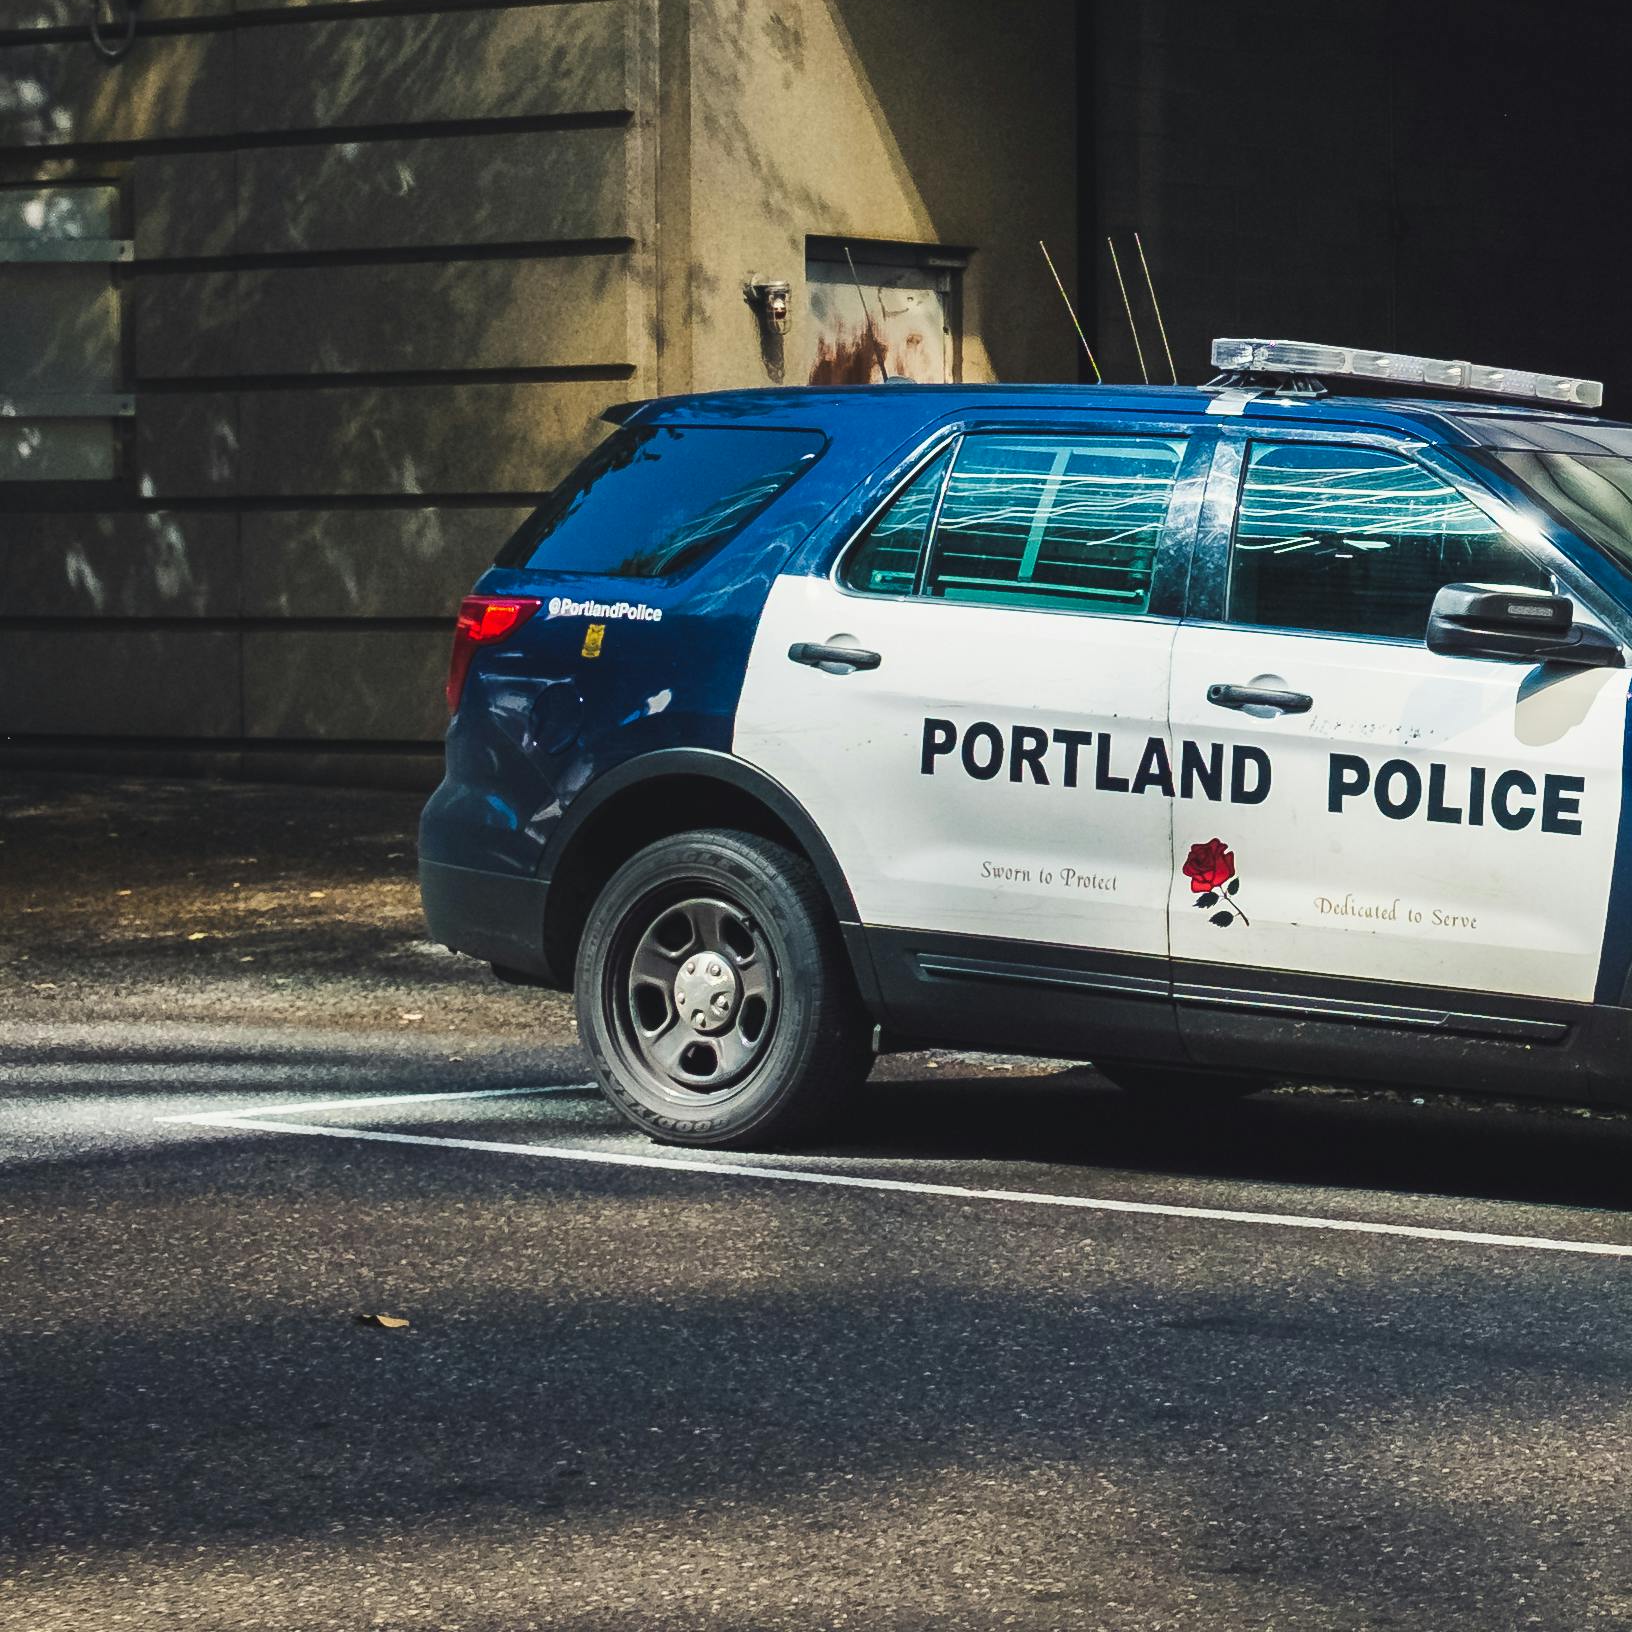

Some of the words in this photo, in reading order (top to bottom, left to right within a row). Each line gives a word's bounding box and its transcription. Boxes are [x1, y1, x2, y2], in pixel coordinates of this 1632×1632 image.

[548, 597, 662, 622] @PortlandPolice
[920, 718, 1273, 806] PORTLAND
[1327, 752, 1586, 836] POLICE
[980, 860, 1031, 882] Sworn
[1039, 867, 1053, 885] to
[1060, 867, 1117, 891] Protect
[1313, 893, 1401, 921] Dedicated
[1407, 908, 1423, 924] to
[1431, 908, 1478, 930] Serve
